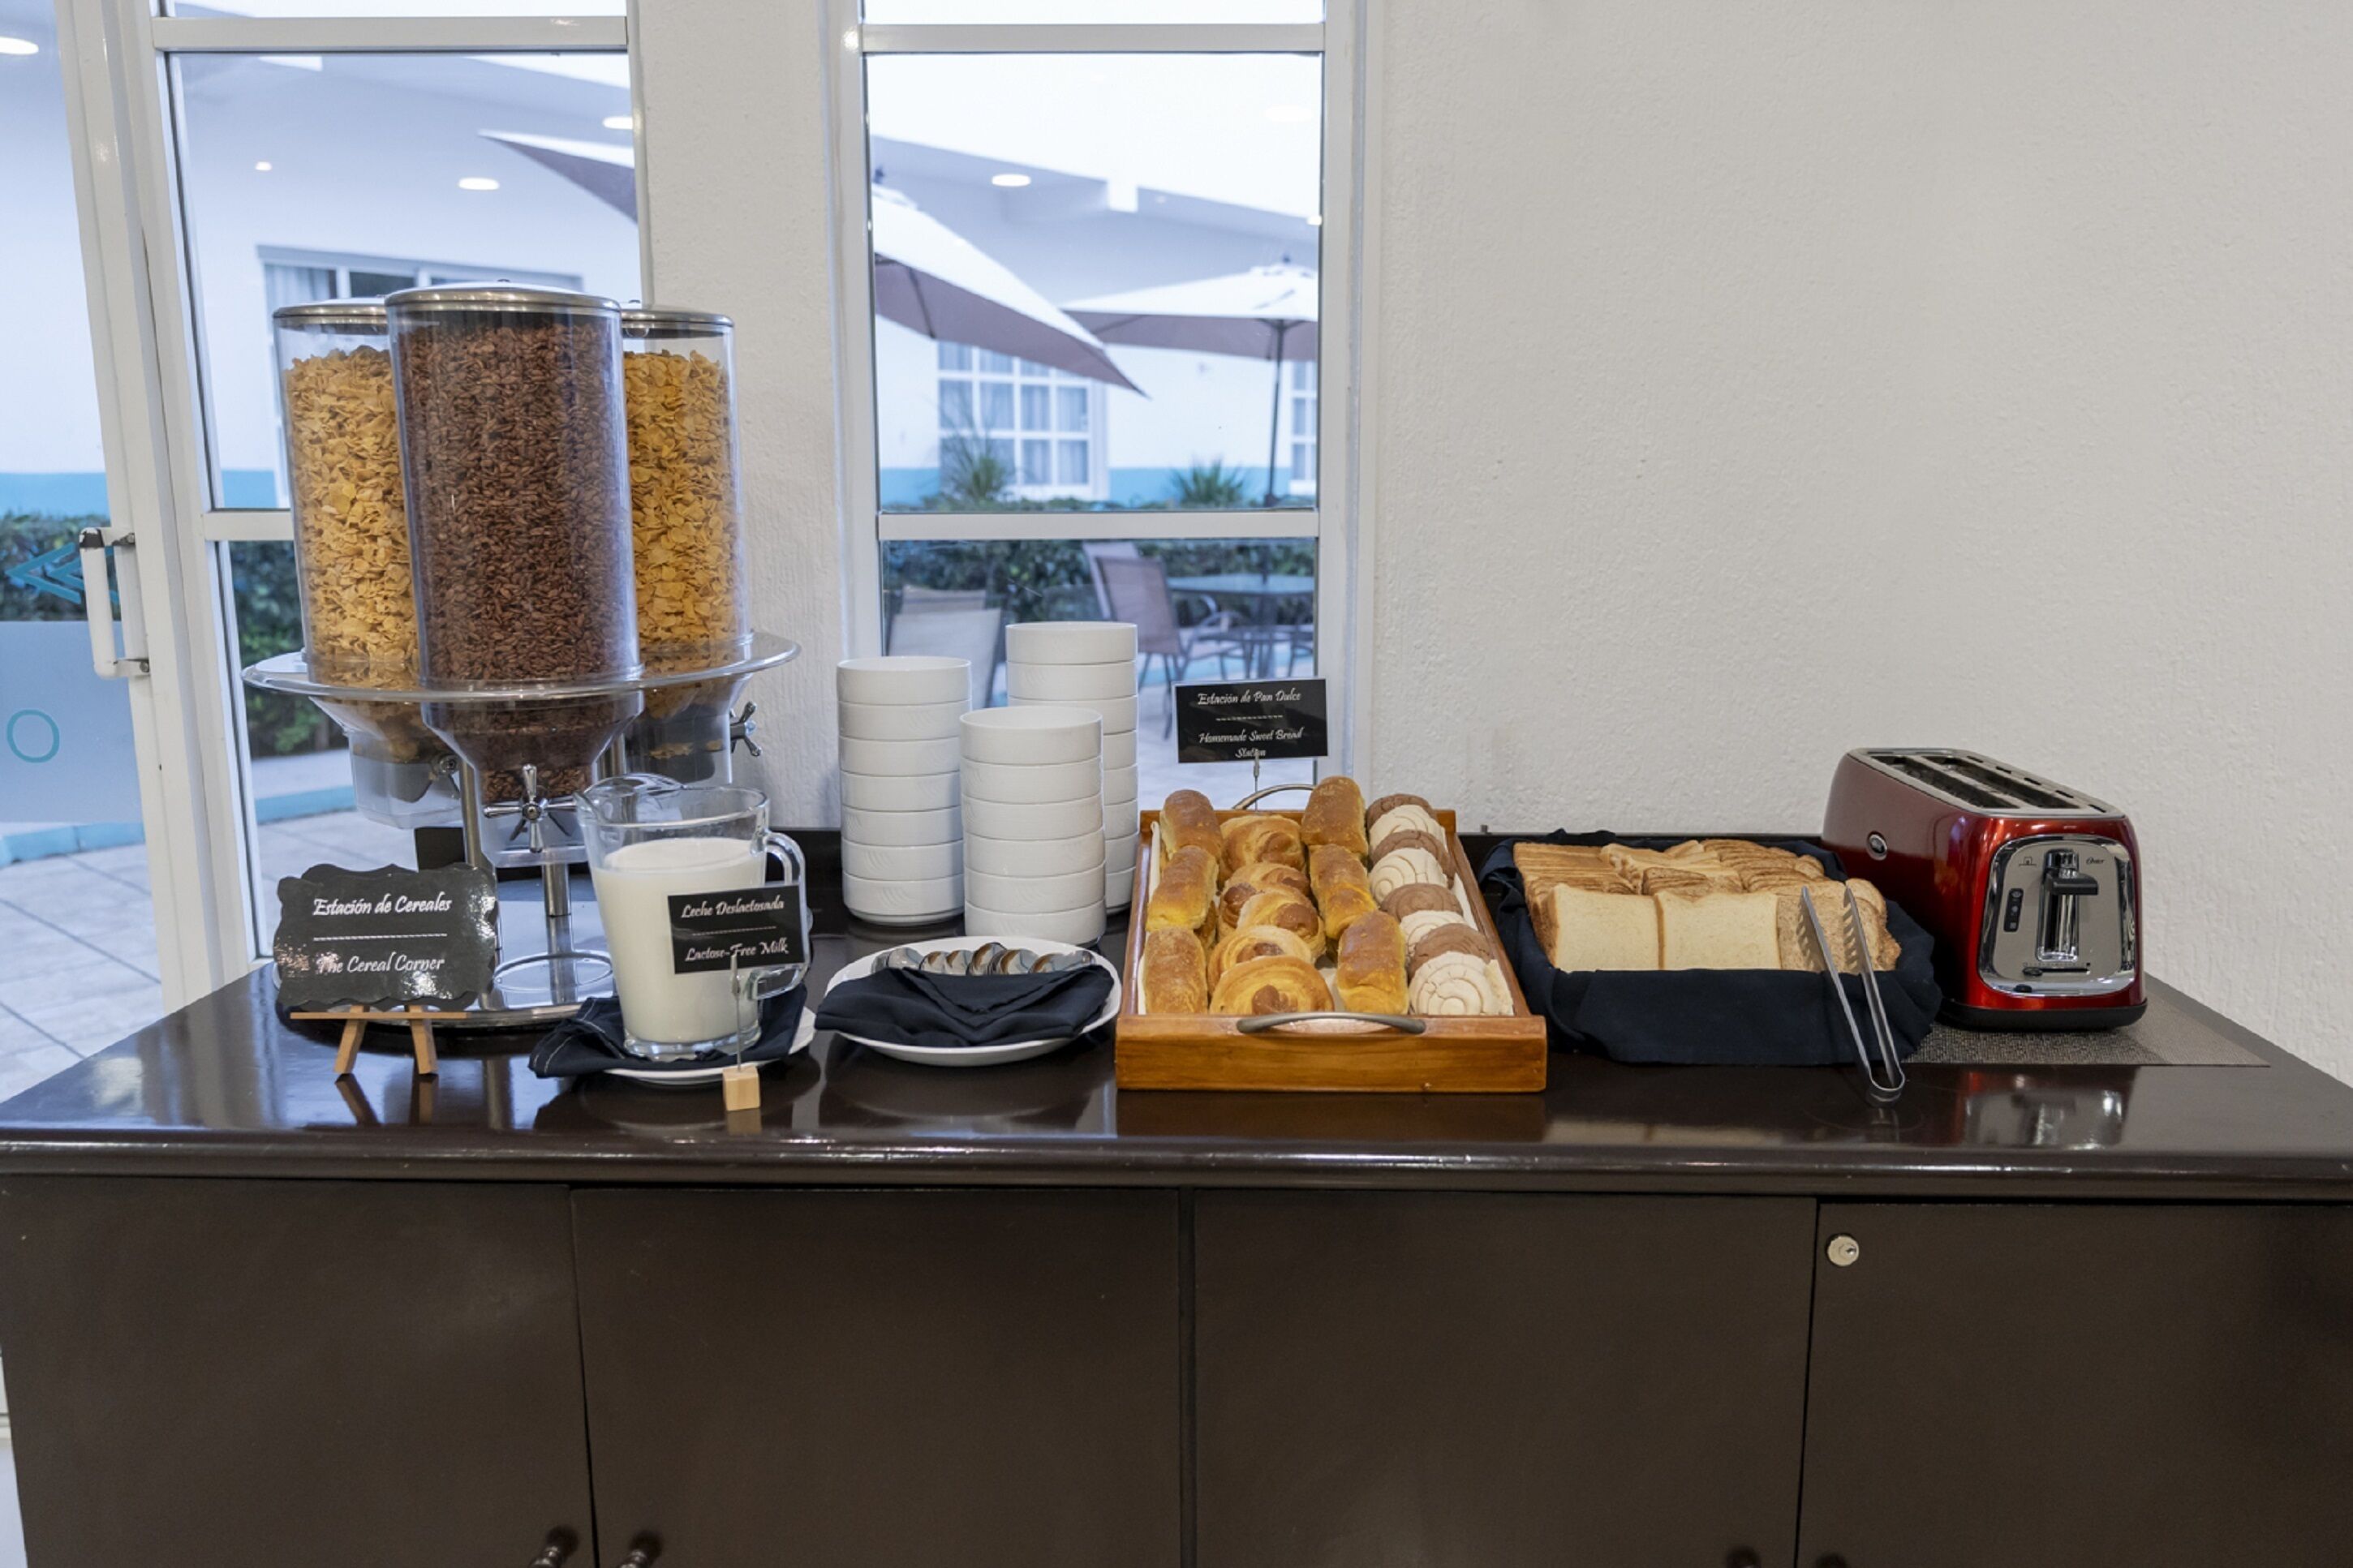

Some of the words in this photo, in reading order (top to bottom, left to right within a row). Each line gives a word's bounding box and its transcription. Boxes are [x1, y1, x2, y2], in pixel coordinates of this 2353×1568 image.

[1198, 692, 1238, 705] Estación
[1240, 689, 1251, 703] de
[1253, 690, 1273, 702] Pan
[1275, 687, 1301, 702] Dulce
[1198, 728, 1247, 744] Homemade
[1249, 729, 1275, 742] Sweet
[1275, 726, 1305, 741] Bread
[312, 898, 372, 916] Estación
[374, 892, 393, 914] de
[394, 891, 453, 913] Cereales
[682, 900, 714, 918] Leche
[715, 894, 785, 916] Deslactosada
[685, 943, 757, 962] Lactose-Free
[759, 936, 789, 955] Milk
[316, 956, 344, 973] The
[346, 951, 396, 973] Cereal
[394, 954, 445, 972] Corner
